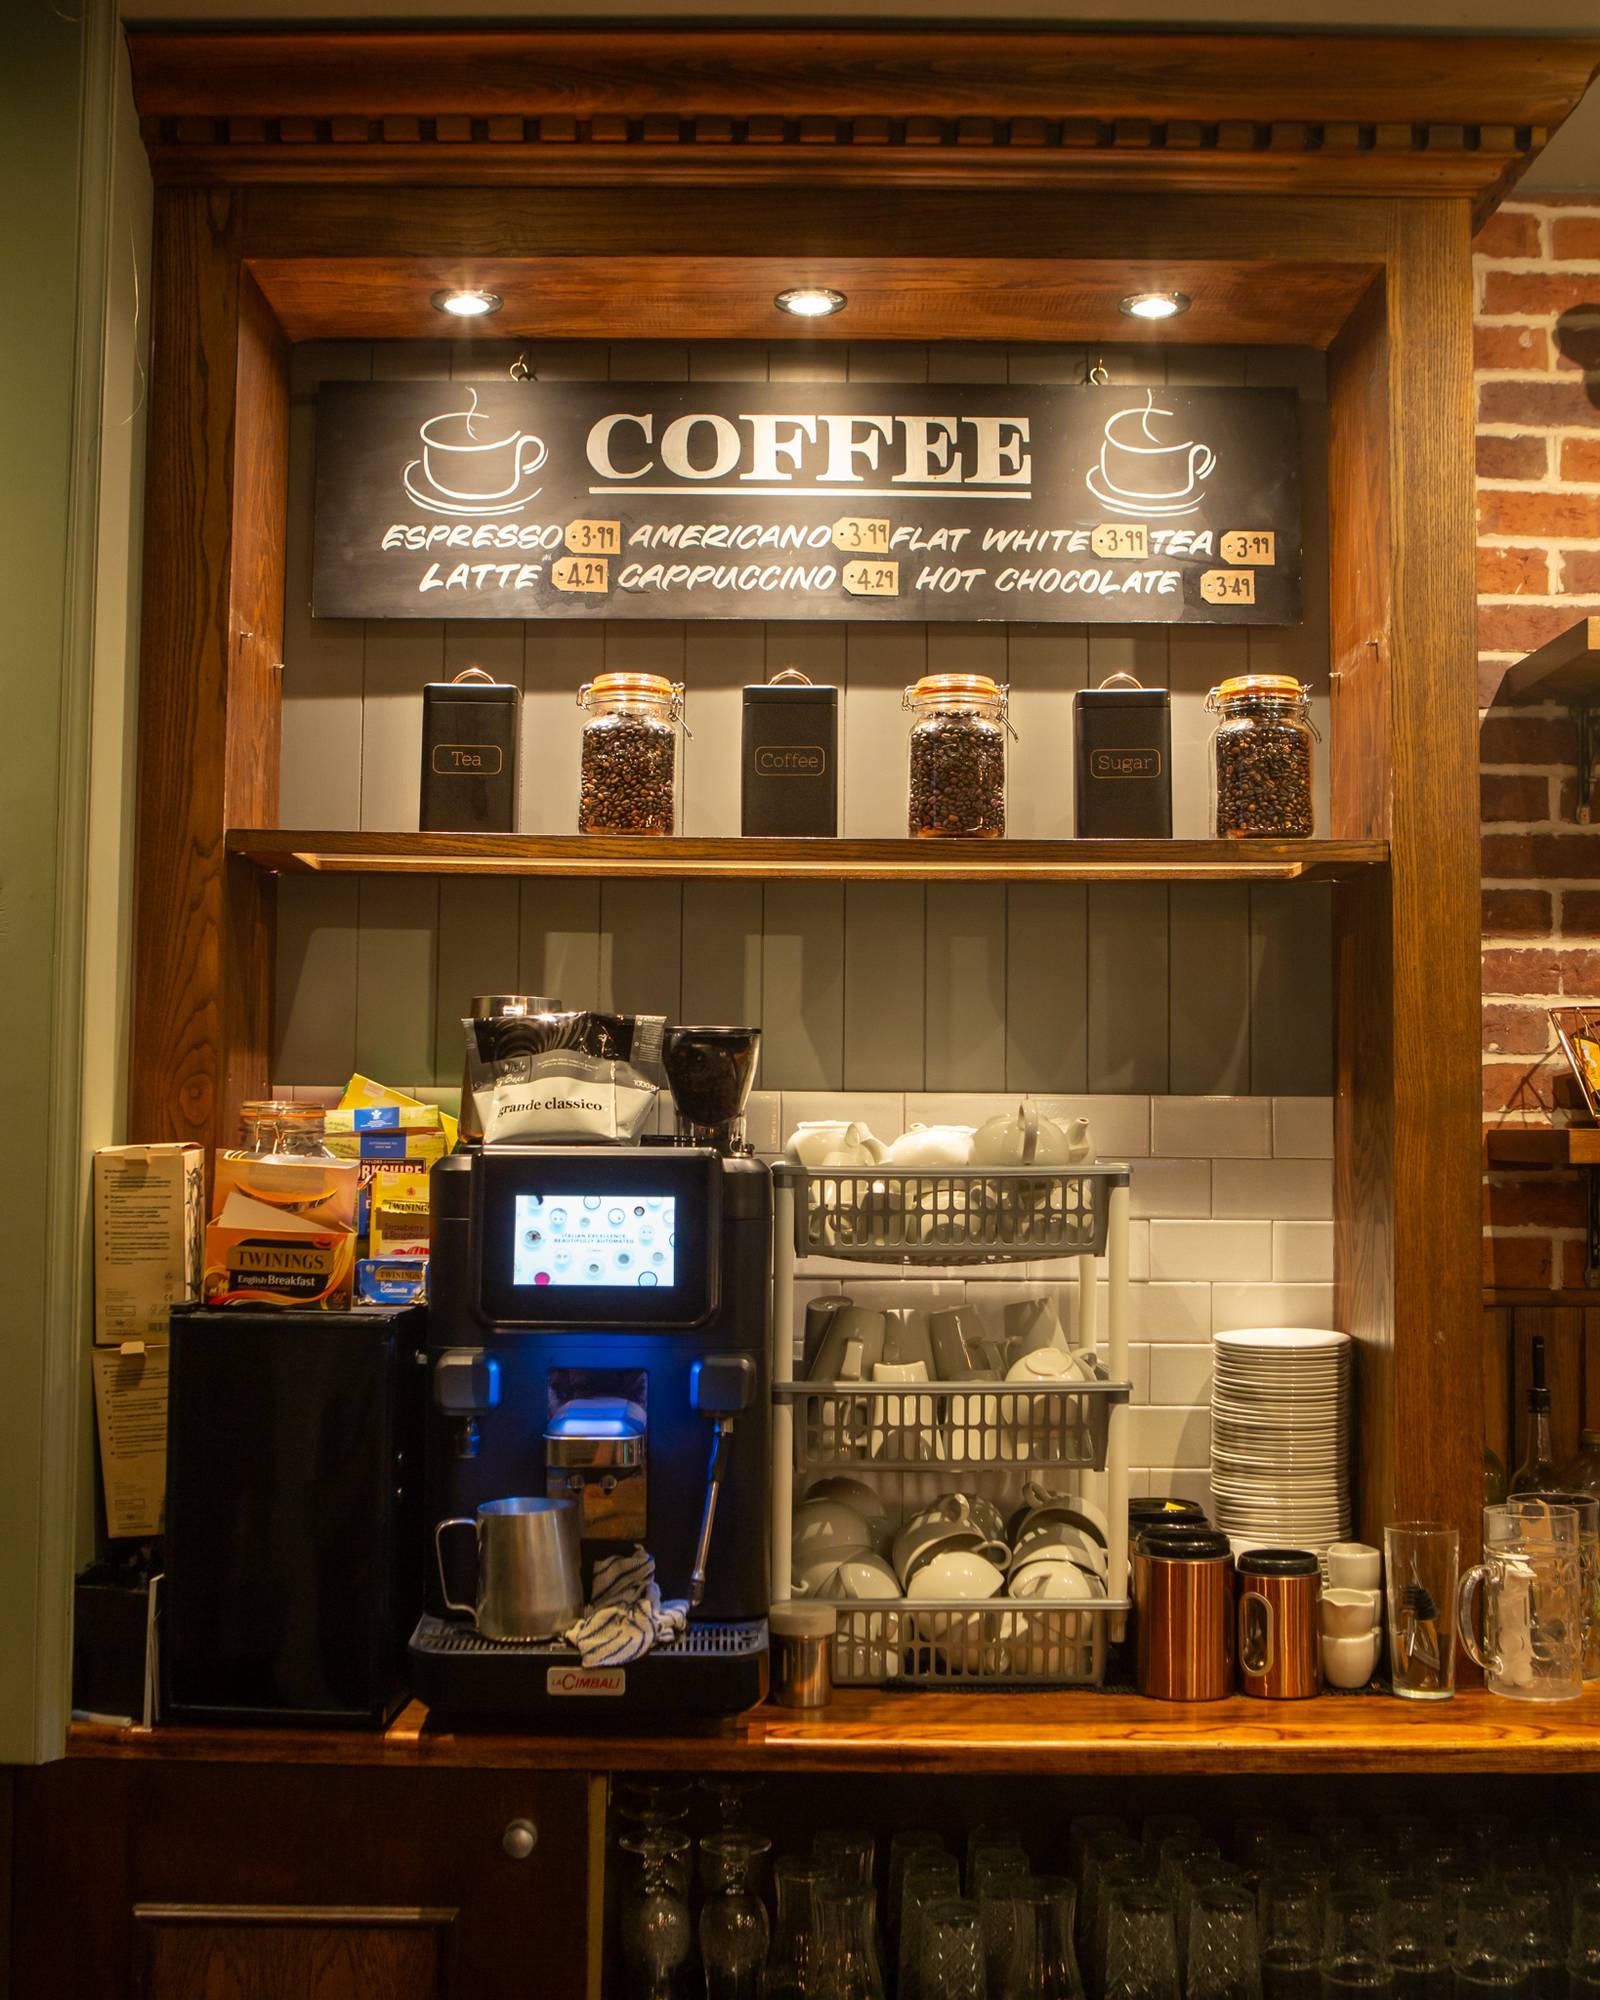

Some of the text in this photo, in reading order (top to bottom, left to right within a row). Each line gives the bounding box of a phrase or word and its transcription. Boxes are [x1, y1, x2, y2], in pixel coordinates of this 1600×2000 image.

[585, 413, 1032, 485] COFFEE
[381, 523, 562, 552] ESPRESSO
[627, 523, 832, 552] AMERICANO
[889, 526, 1091, 555] FLAT WHITE
[1150, 528, 1213, 556] TEA
[418, 562, 541, 593] LATTE
[618, 562, 836, 592] CAPPUCCINO
[915, 566, 1182, 595] HOT CHOCOLATE
[452, 750, 482, 770] Tea
[760, 750, 819, 770] Coffee
[1099, 754, 1154, 774] Sugar
[497, 1096, 603, 1118] grande classico
[238, 1251, 324, 1269] TWININGS
[237, 1274, 316, 1286] English Breakfast
[562, 1673, 621, 1690] CIMBALI
